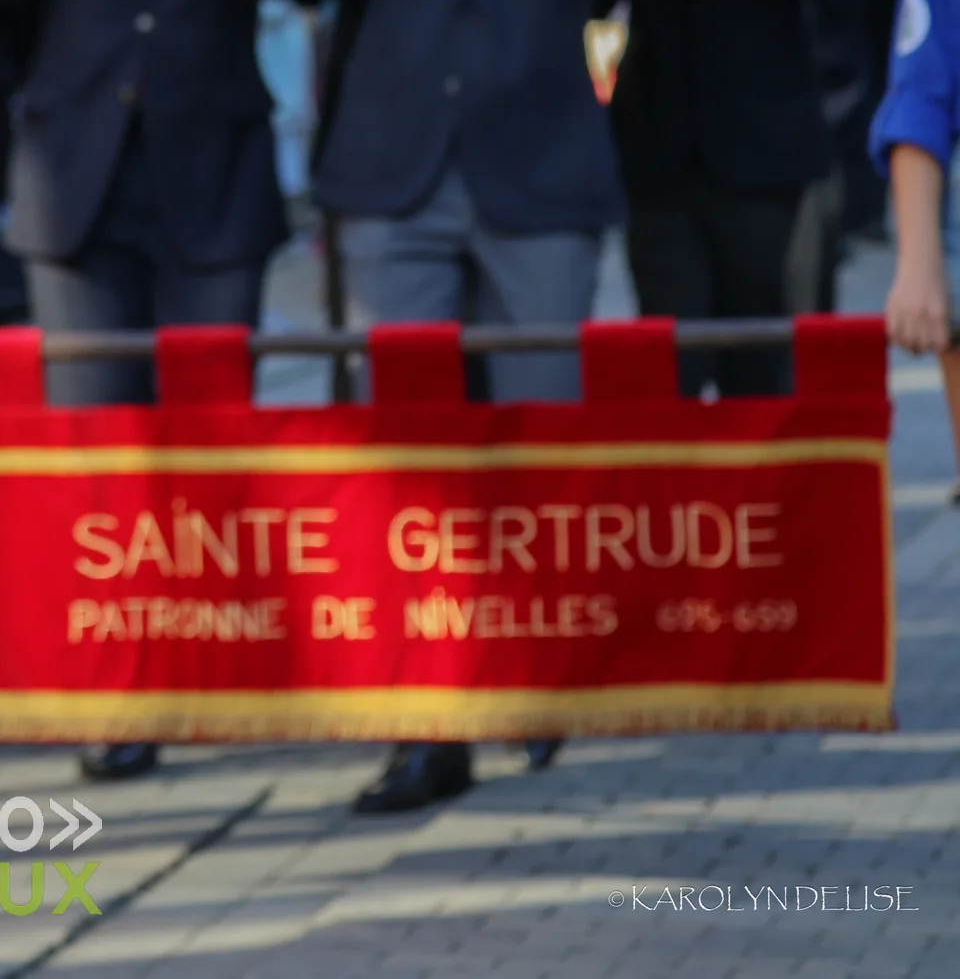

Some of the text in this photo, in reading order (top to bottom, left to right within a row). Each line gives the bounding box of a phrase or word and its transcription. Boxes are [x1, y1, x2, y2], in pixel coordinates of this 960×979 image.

[387, 500, 785, 573] GERTRUDE
[67, 596, 287, 644] PATRONNE
[311, 595, 377, 640] DE
